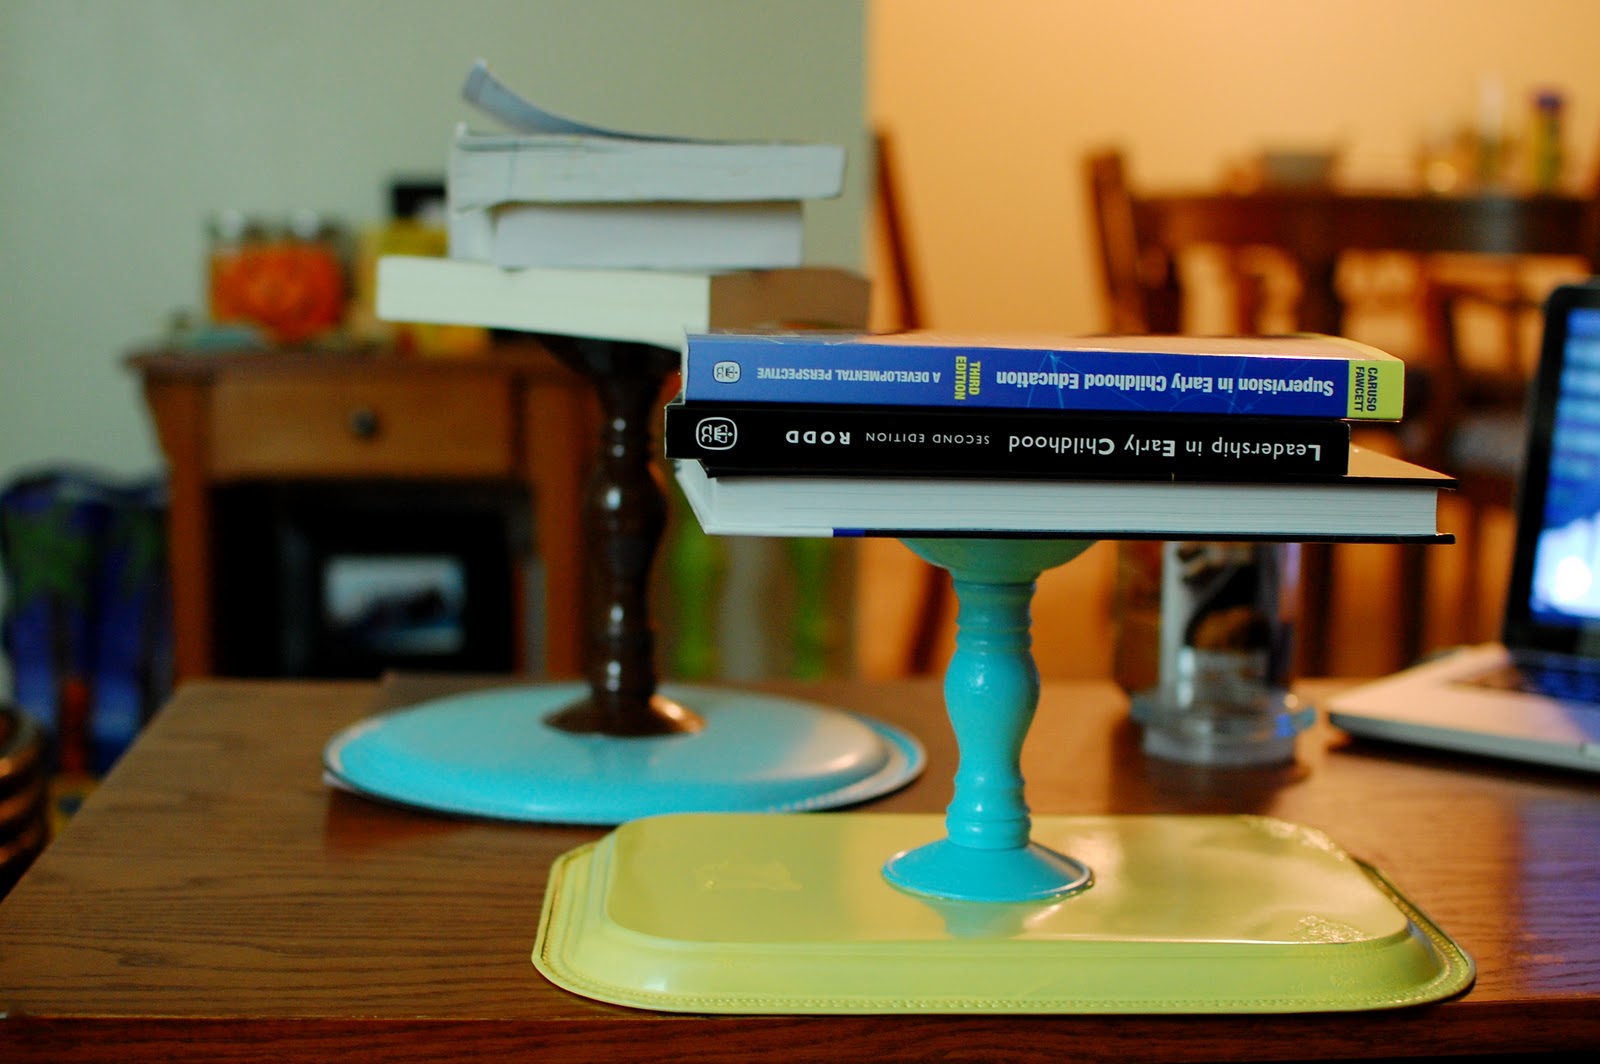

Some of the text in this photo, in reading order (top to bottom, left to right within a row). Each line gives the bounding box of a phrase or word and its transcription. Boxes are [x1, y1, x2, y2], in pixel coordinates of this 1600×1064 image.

[757, 367, 941, 383] A DEVELOPMENTAL PERSPECTIVE
[955, 356, 967, 400] EDITION
[968, 361, 981, 396] THIRD
[997, 371, 1334, 396] Supervision in Early Childhood Education
[1354, 366, 1364, 412] FAWCETT
[1367, 367, 1378, 412] CARUSO
[785, 430, 850, 445] RODD
[865, 432, 990, 445] SECOND EDITION
[1009, 434, 1321, 461] Leadership in Early Childhood
